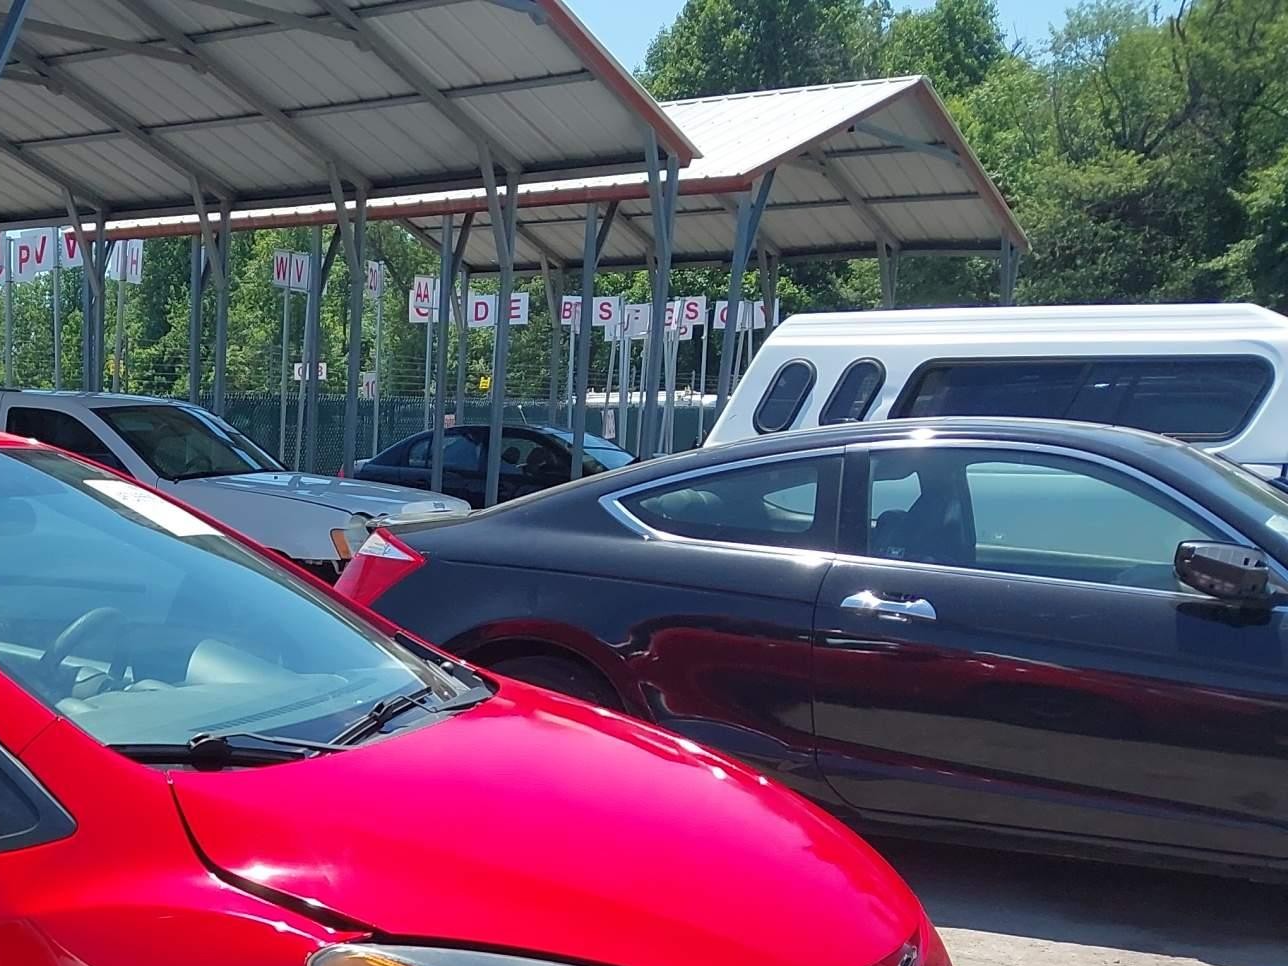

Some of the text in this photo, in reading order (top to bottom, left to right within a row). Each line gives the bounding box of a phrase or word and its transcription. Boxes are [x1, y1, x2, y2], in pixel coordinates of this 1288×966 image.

[18, 245, 30, 274] P
[276, 256, 288, 280] W
[296, 259, 304, 282] V
[416, 282, 429, 302] AA
[474, 301, 489, 321] D
[562, 302, 572, 319] B
[599, 302, 612, 320] S
[686, 302, 699, 320] S
